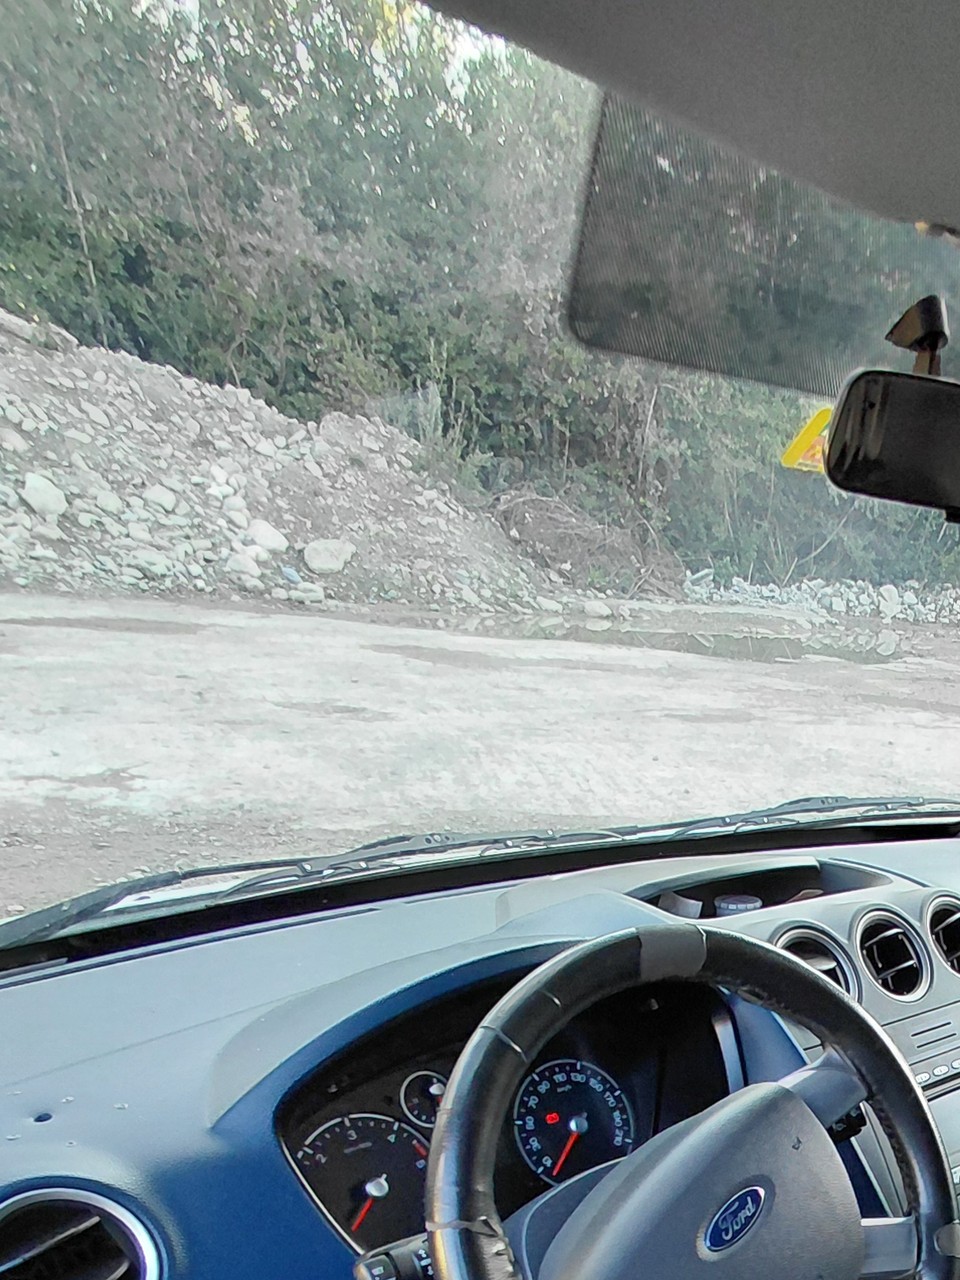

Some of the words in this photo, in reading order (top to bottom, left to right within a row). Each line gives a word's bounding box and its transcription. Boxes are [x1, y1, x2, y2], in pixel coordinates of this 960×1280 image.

[603, 1091, 616, 1107] 170
[347, 1130, 357, 1140] 3
[387, 1134, 396, 1143] 4
[315, 1153, 327, 1164] 2
[717, 1196, 756, 1241] Ford
